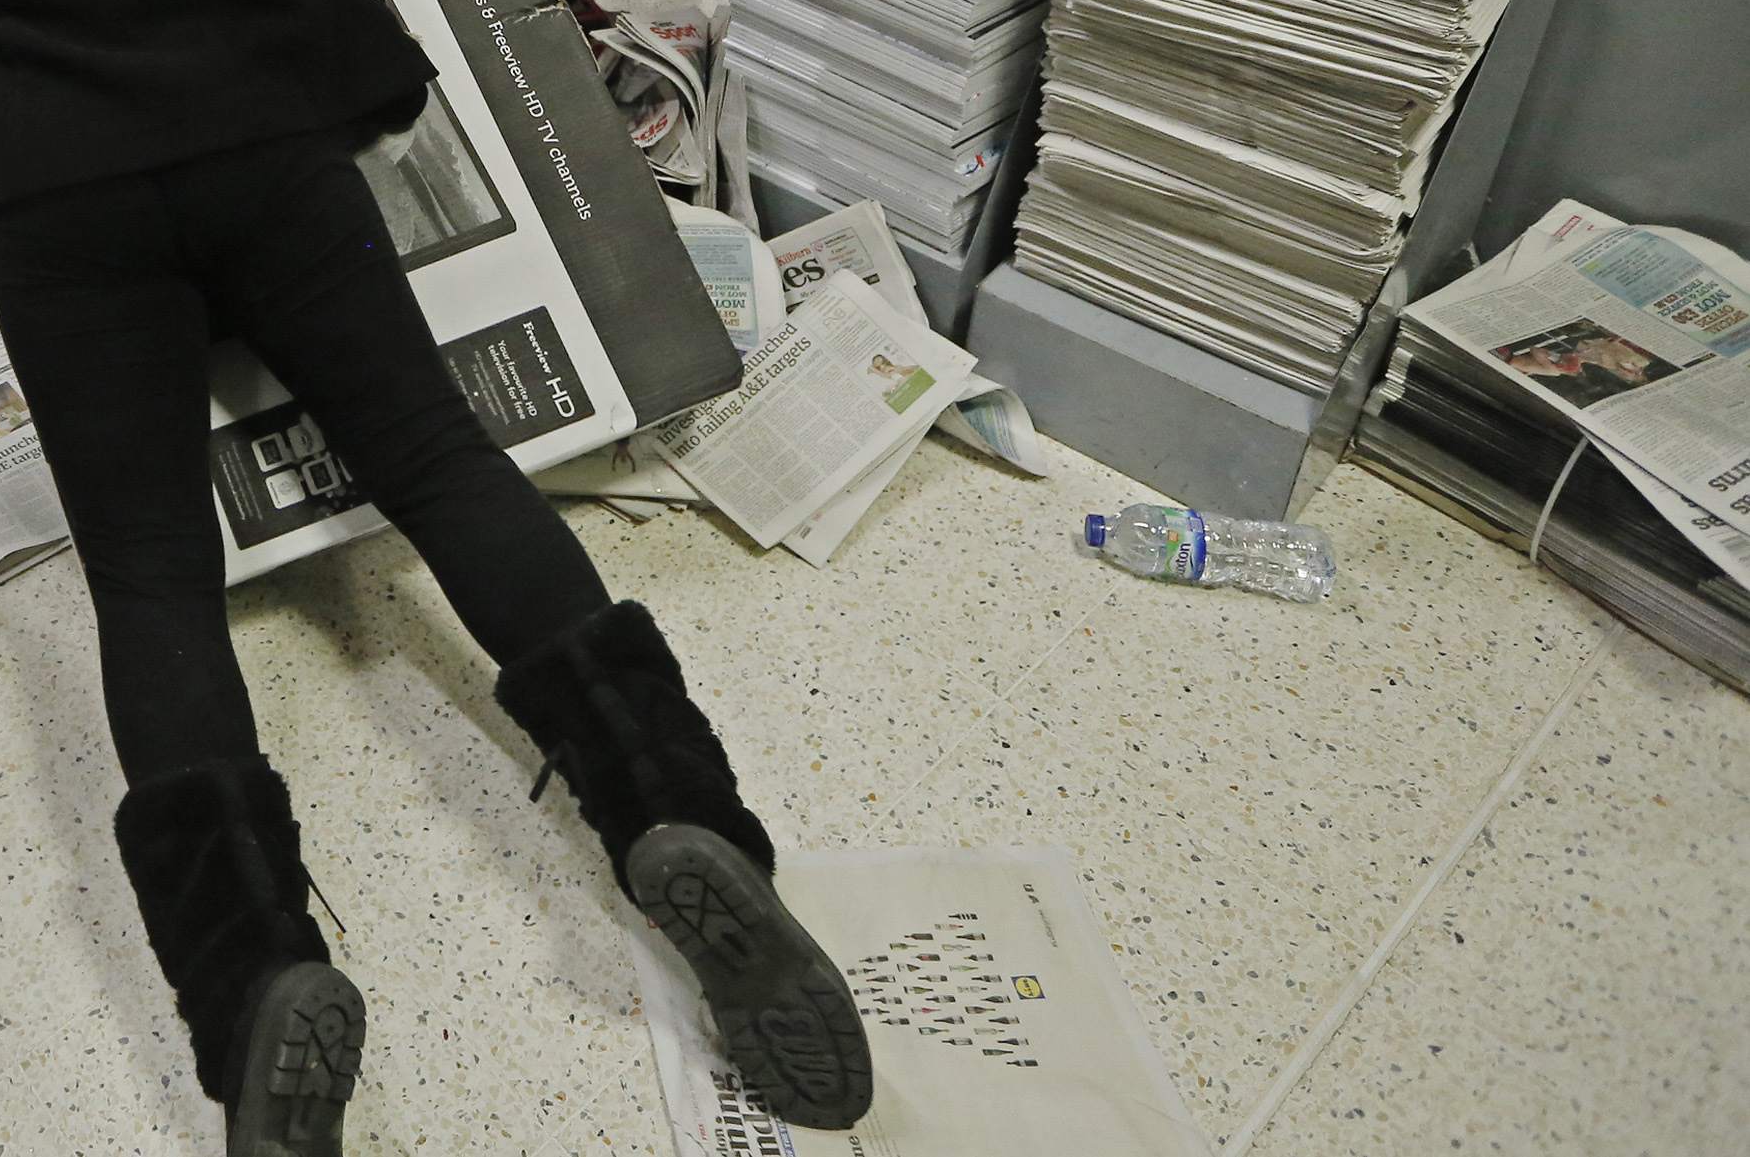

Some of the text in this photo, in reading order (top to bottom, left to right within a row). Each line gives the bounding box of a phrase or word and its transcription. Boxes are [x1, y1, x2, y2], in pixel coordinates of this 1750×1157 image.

[480, 7, 496, 22] &
[488, 19, 530, 91] Freeview
[521, 89, 545, 119] HD
[537, 118, 560, 144] TV
[549, 147, 593, 221] channels
[1699, 288, 1733, 313] MOT
[487, 344, 527, 421] television for free
[497, 339, 537, 418] Your favourite HD
[522, 320, 575, 419] Freeview HD
[672, 336, 812, 459] into failing A&E targets
[11, 445, 43, 477] targe
